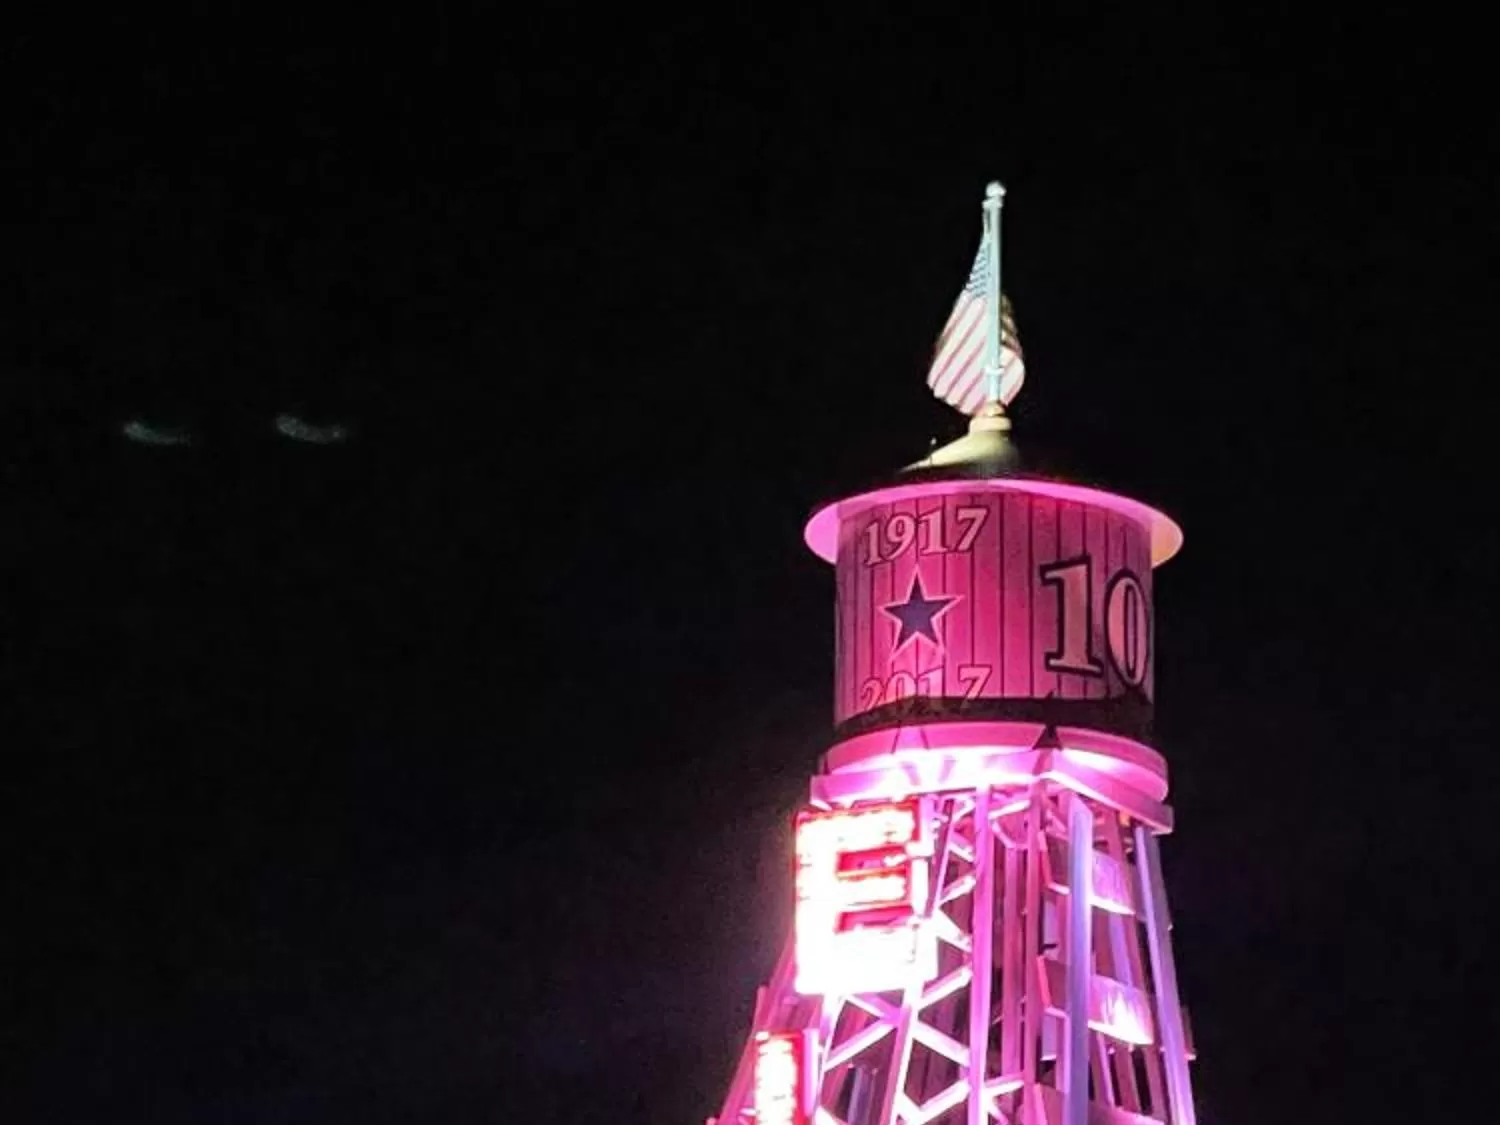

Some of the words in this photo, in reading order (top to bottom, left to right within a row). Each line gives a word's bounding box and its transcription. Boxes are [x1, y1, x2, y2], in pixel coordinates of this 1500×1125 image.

[862, 505, 990, 568] 1917
[1039, 552, 1150, 689] 10
[861, 663, 994, 711] 2017
